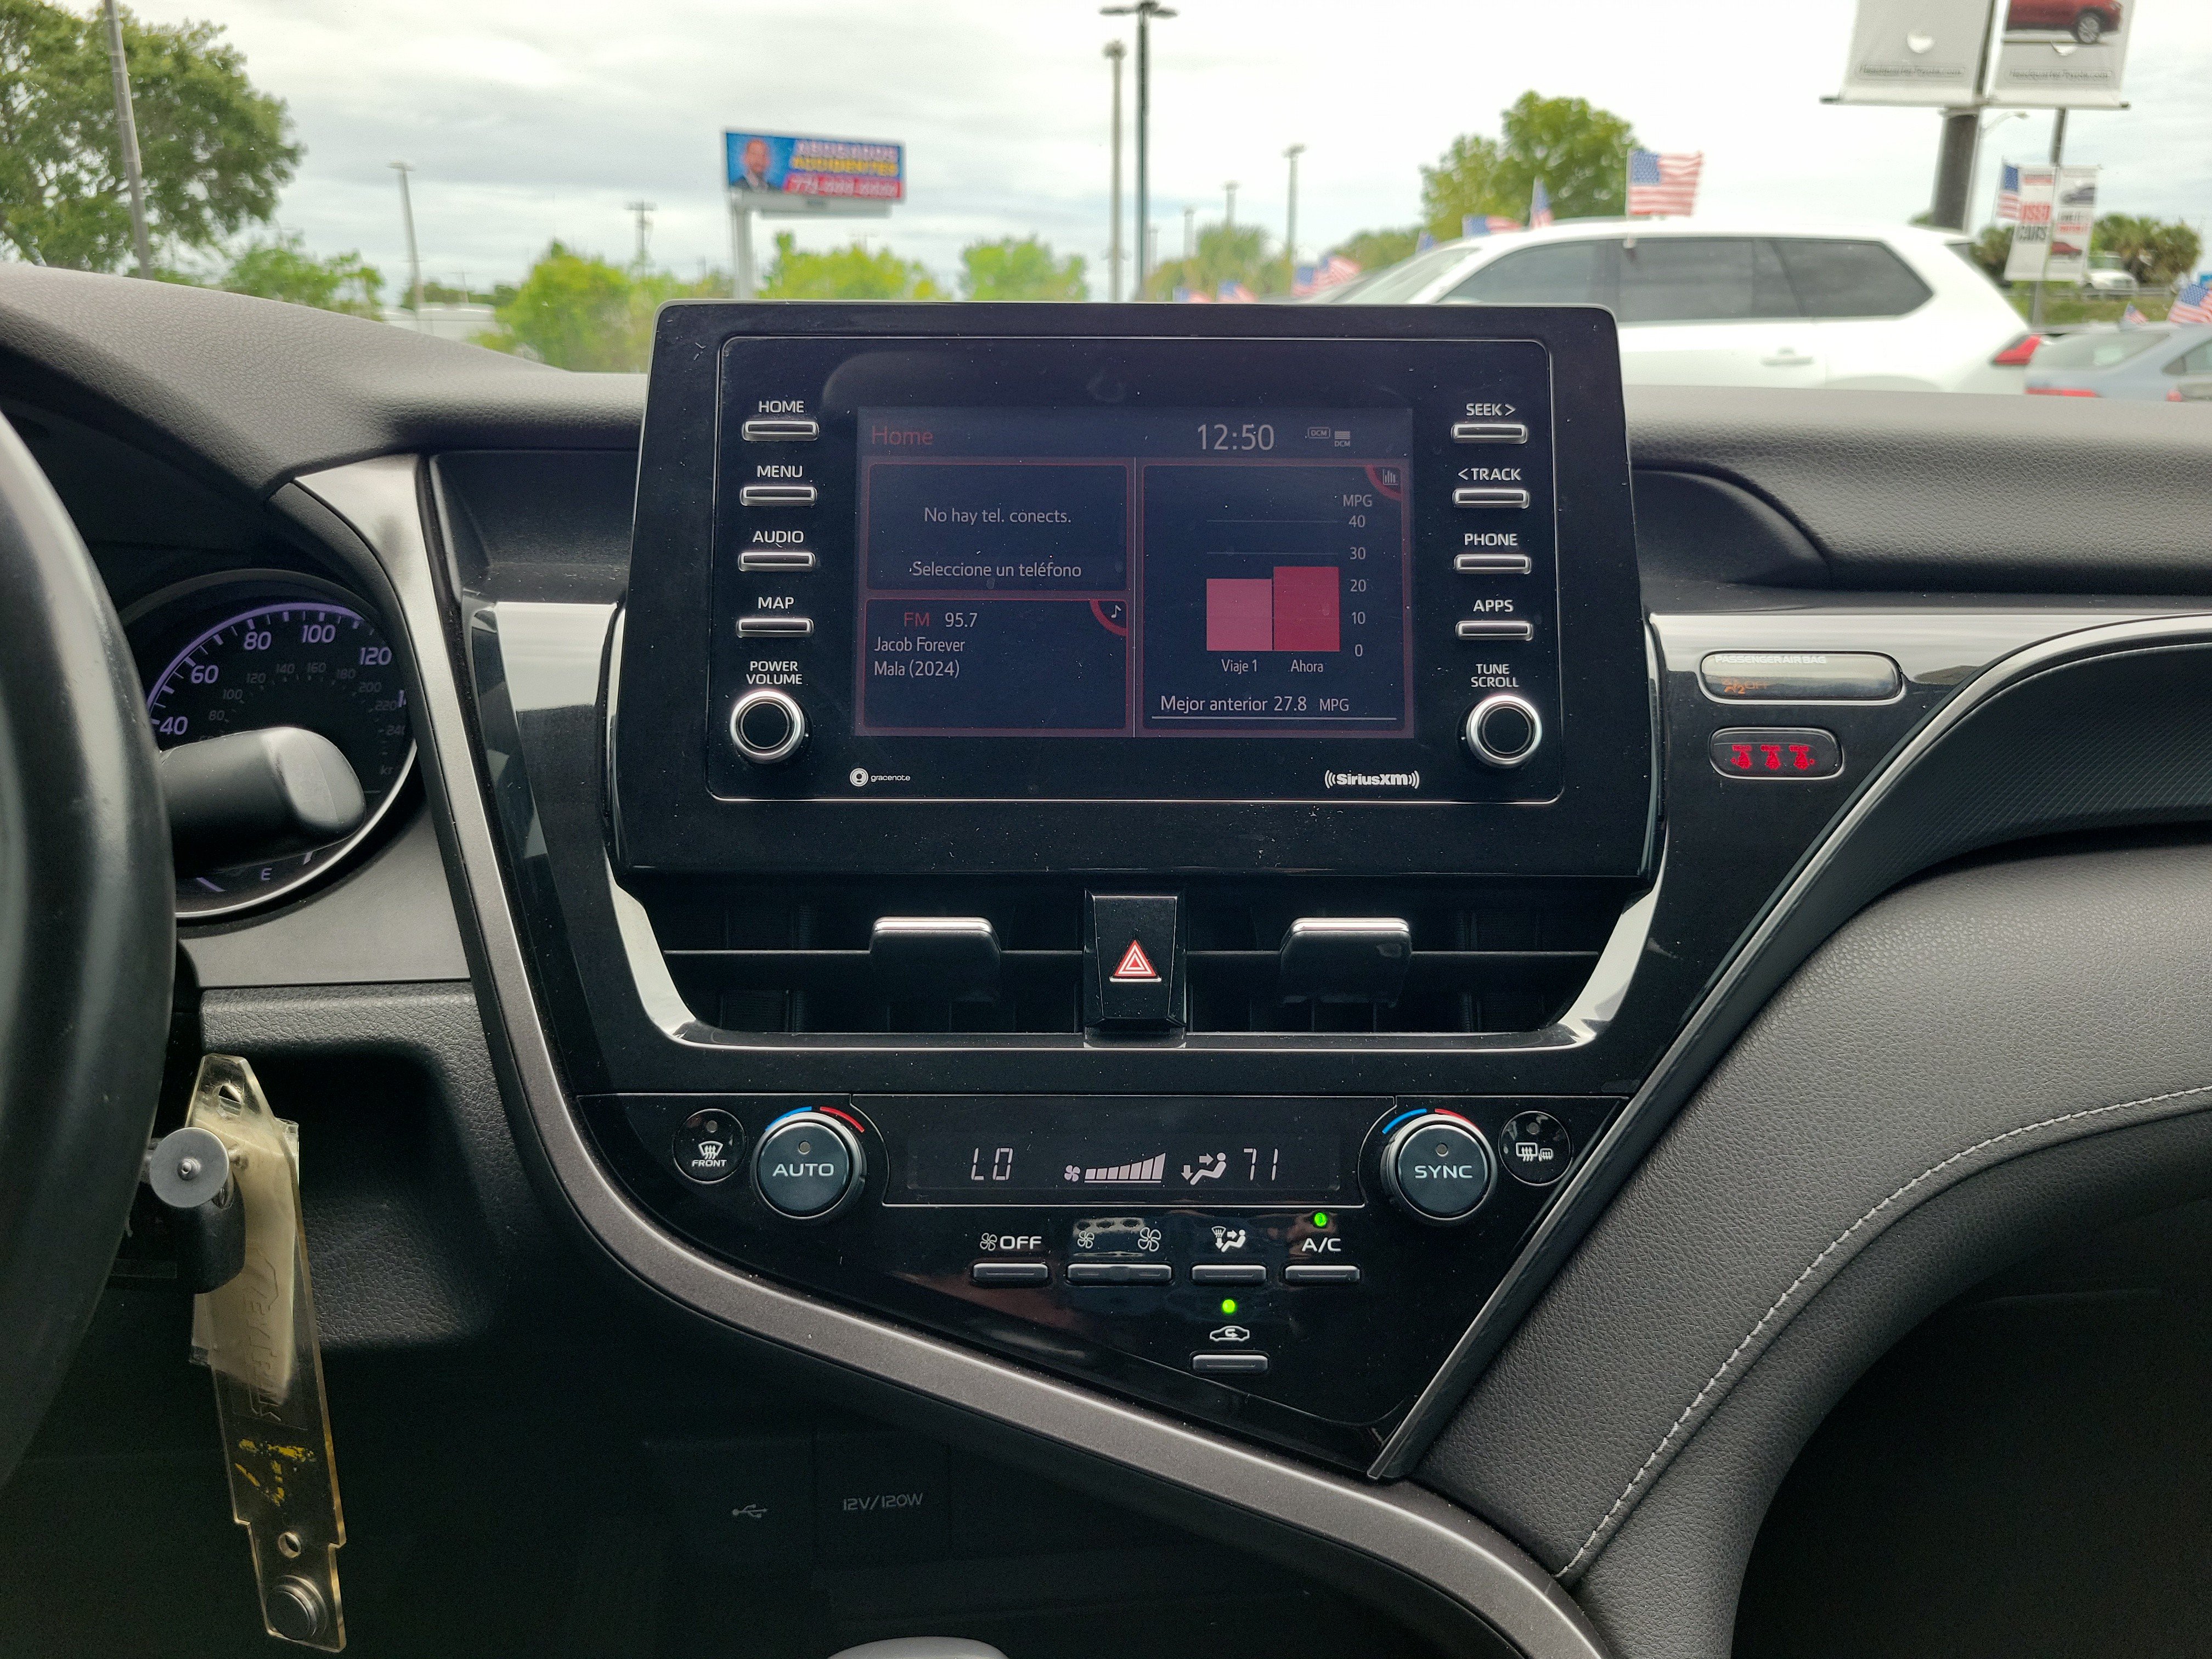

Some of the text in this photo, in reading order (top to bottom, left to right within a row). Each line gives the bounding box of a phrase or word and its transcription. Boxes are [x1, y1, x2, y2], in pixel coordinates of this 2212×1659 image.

[758, 400, 804, 413] HOME
[871, 424, 933, 446] Home
[1198, 424, 1274, 450] 12:50
[757, 465, 803, 478] MENU
[1343, 494, 1373, 507] MPG
[924, 507, 1071, 526] No hay tel. conects.
[1348, 515, 1365, 528] 40
[752, 531, 804, 543] AUDIO
[1464, 533, 1518, 546] PHONE
[1350, 546, 1366, 560] 30
[912, 561, 1081, 577] Seleccione un teléfono
[1350, 579, 1367, 592] 20
[758, 596, 794, 609] MAP
[1473, 599, 1514, 612] APPS
[904, 612, 978, 628] FM 95.7
[1351, 611, 1366, 624] 10
[243, 631, 272, 650] 80
[302, 624, 336, 643] 100
[874, 636, 966, 653] Jacob Forever
[1355, 644, 1363, 657] 0
[360, 646, 392, 665] 120
[1714, 654, 1826, 664] PASSENGER AIR BAG
[750, 661, 798, 672] POWER
[874, 659, 960, 679] Mala (2024)
[1221, 658, 1257, 675] Viaje 1
[1290, 659, 1324, 673] Ahora
[1475, 663, 1510, 674] TUNE
[189, 664, 219, 684] 60
[246, 672, 266, 684] 120
[746, 674, 803, 685] VOLUME
[1471, 676, 1519, 687] SCROLL
[222, 689, 243, 701] 100
[1161, 695, 1349, 714] Mejor anterior 27.8 MPG
[208, 709, 225, 721] 80
[159, 716, 188, 735] 40
[261, 867, 272, 881] E
[691, 1159, 727, 1167] FRONT
[772, 1163, 834, 1177] AUTO
[1243, 1148, 1278, 1181] 71
[1414, 1165, 1472, 1179] SYNC
[1000, 1235, 1042, 1250] OFF
[1301, 1237, 1341, 1253] A/C
[843, 1493, 923, 1511] 12V/120W
